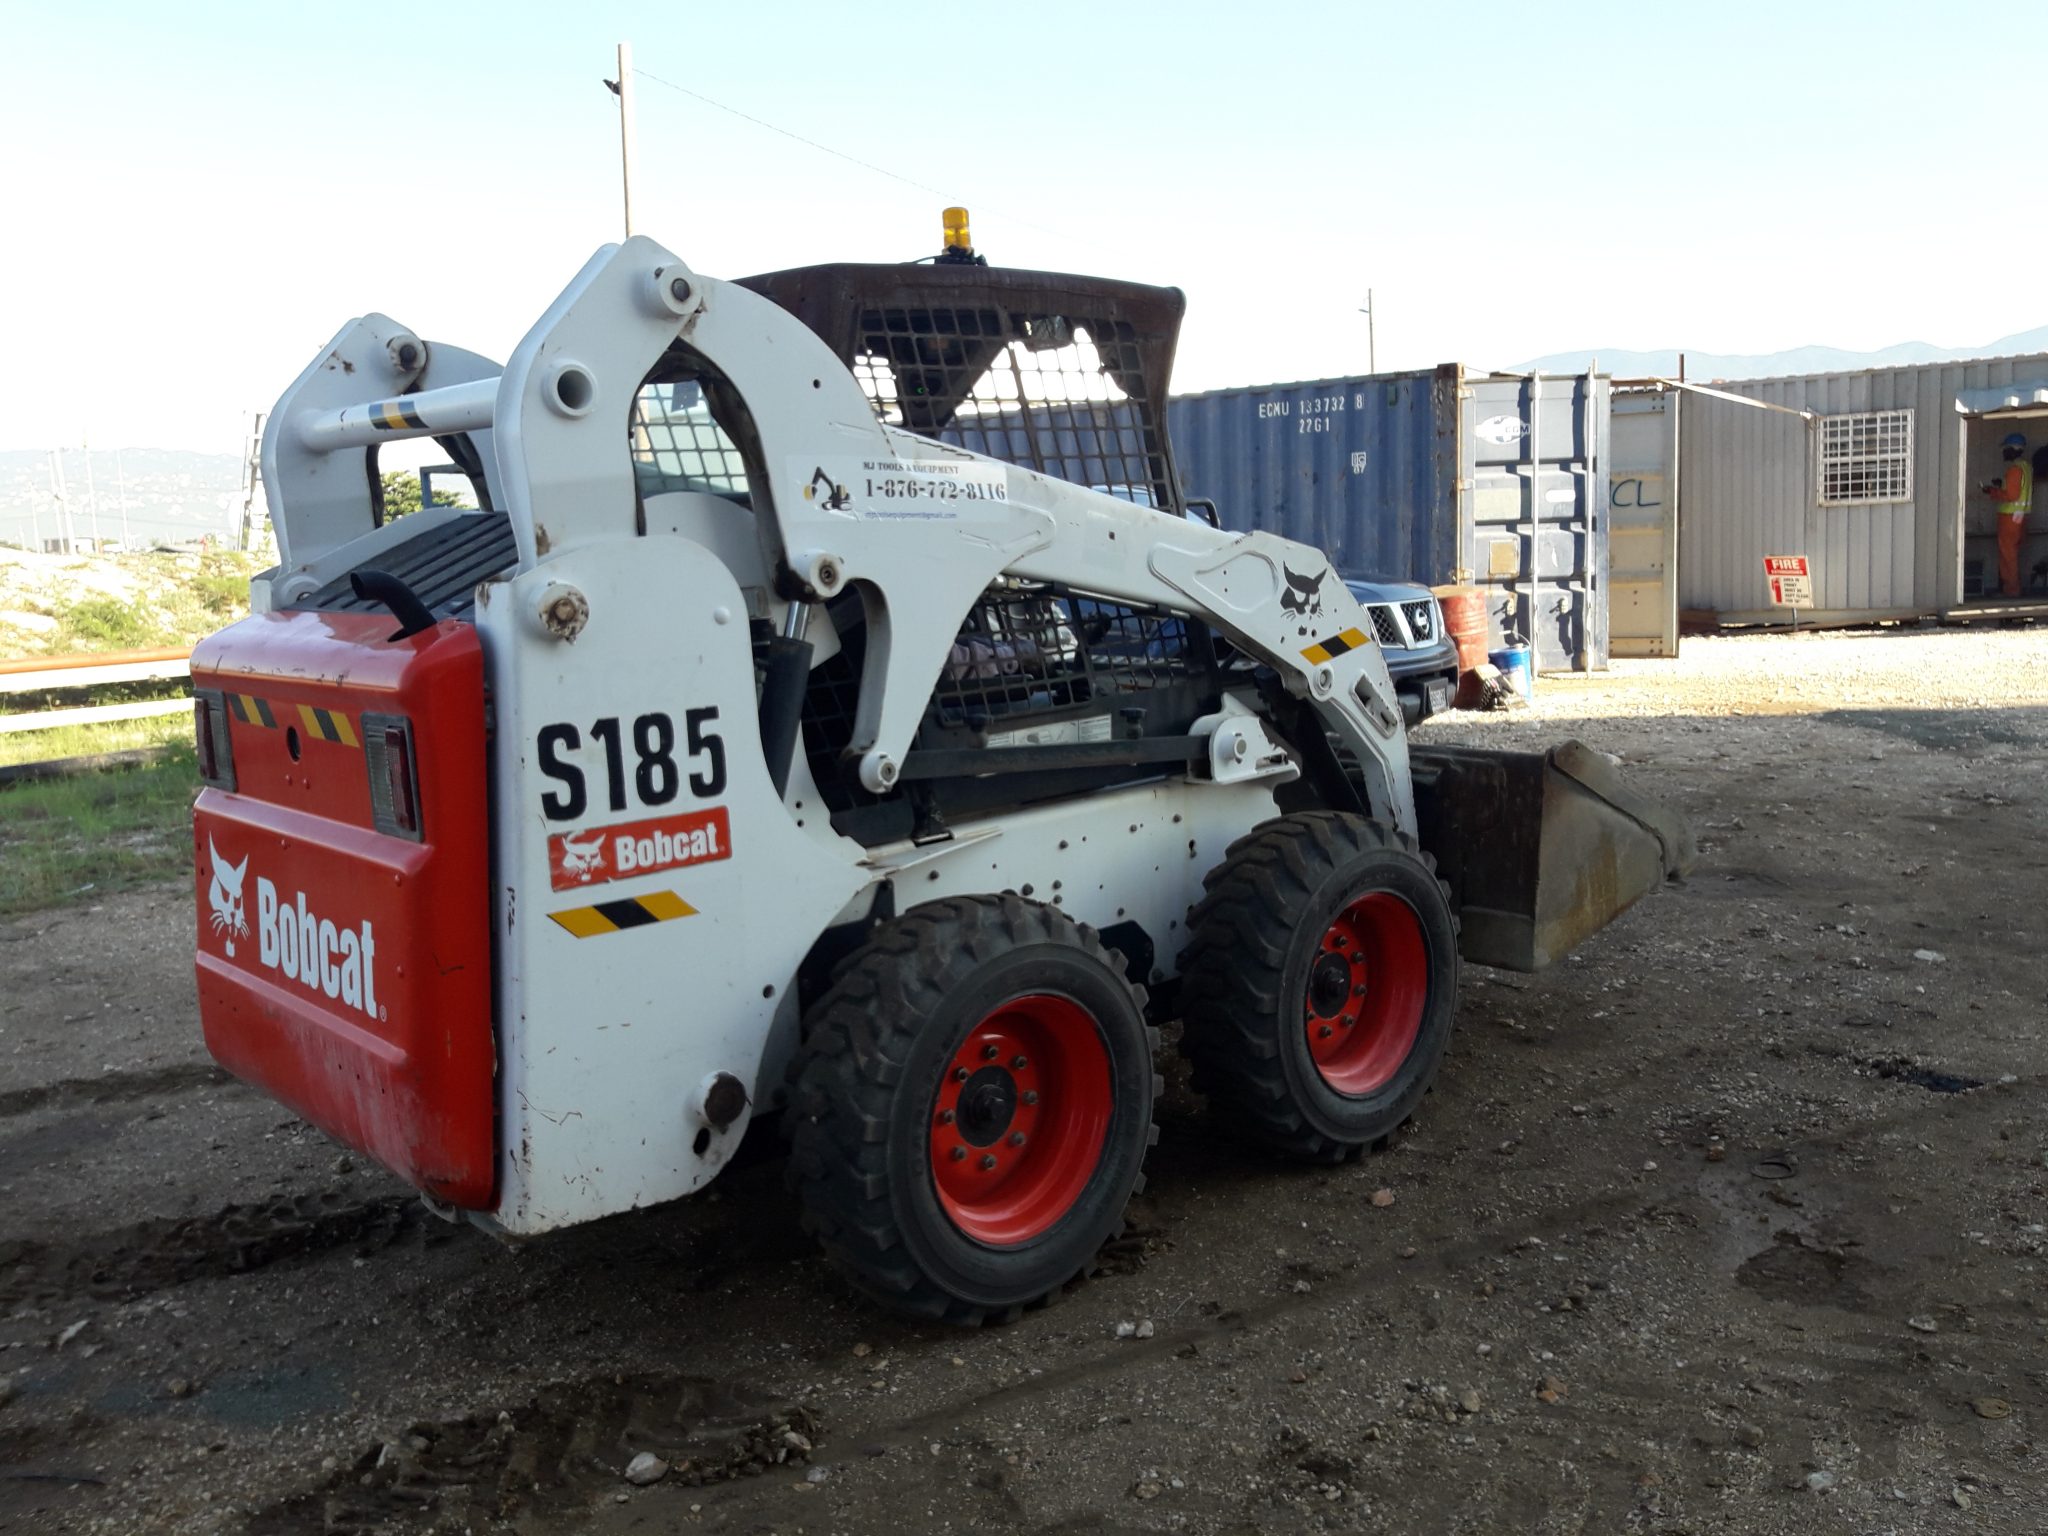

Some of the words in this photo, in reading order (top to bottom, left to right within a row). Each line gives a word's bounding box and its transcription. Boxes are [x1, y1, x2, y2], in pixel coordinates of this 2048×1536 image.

[1259, 402, 1290, 418] ECMU
[1299, 396, 1345, 415] 133732
[1355, 394, 1364, 409] 8
[1299, 417, 1331, 434] 22G1
[863, 462, 875, 470] MJ
[878, 462, 904, 472] TOOLS
[913, 464, 959, 474] EQUIPMENT
[866, 479, 1005, 499] 1-876-772-8116
[1771, 559, 1800, 569] FIRE
[537, 705, 728, 822] S185
[614, 821, 719, 872] Bobcat
[257, 875, 378, 1020] Bobcat
